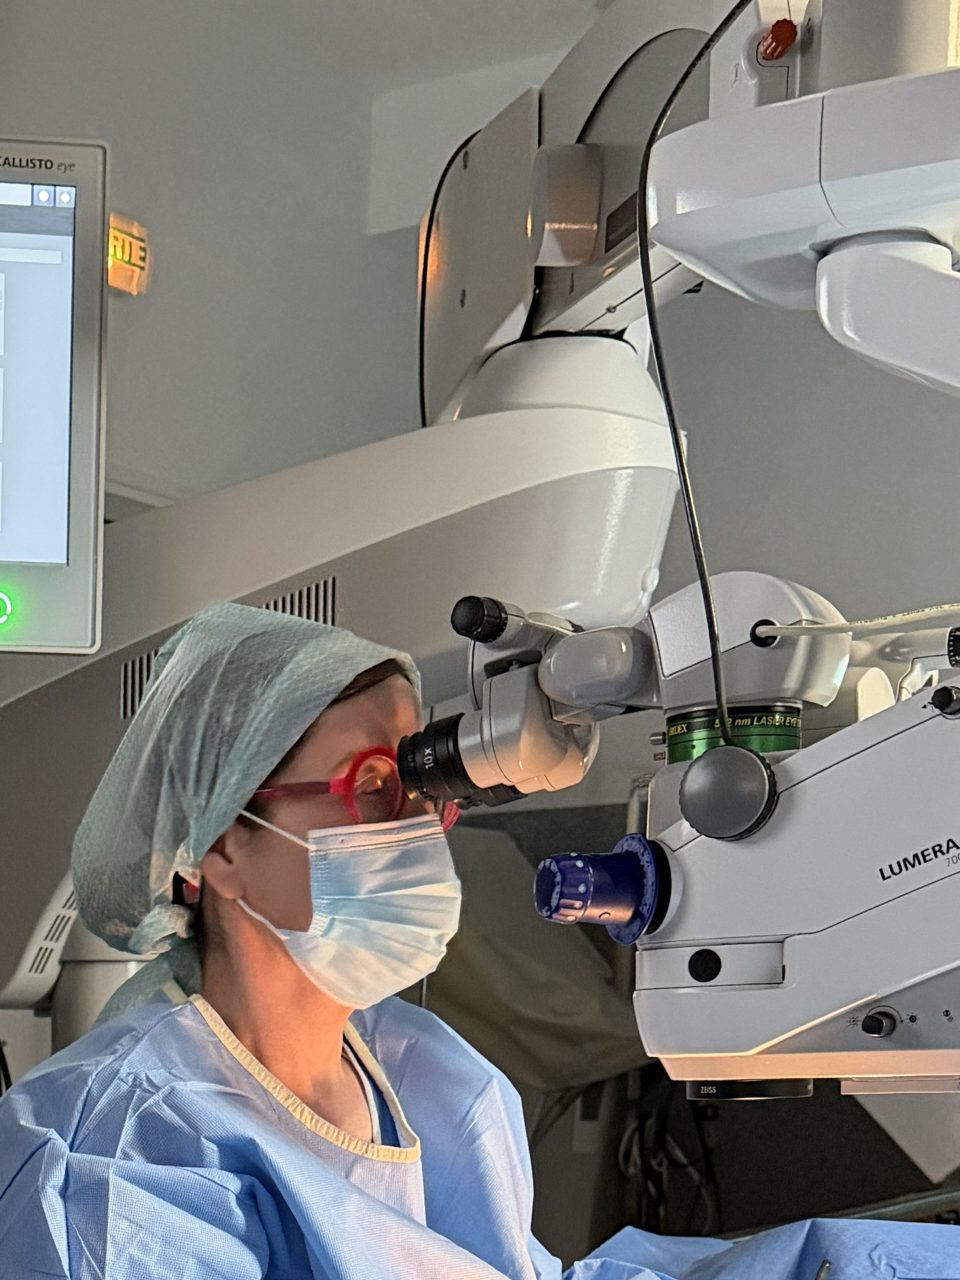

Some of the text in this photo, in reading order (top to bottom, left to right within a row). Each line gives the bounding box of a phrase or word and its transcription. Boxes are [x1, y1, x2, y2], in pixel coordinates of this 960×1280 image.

[57, 162, 76, 174] eye
[110, 234, 147, 265] RTIE
[714, 718, 733, 728] 52
[735, 718, 751, 727] nm
[753, 716, 785, 726] LASER
[879, 838, 960, 881] LUMERA
[700, 1086, 717, 1094] ZEISS
